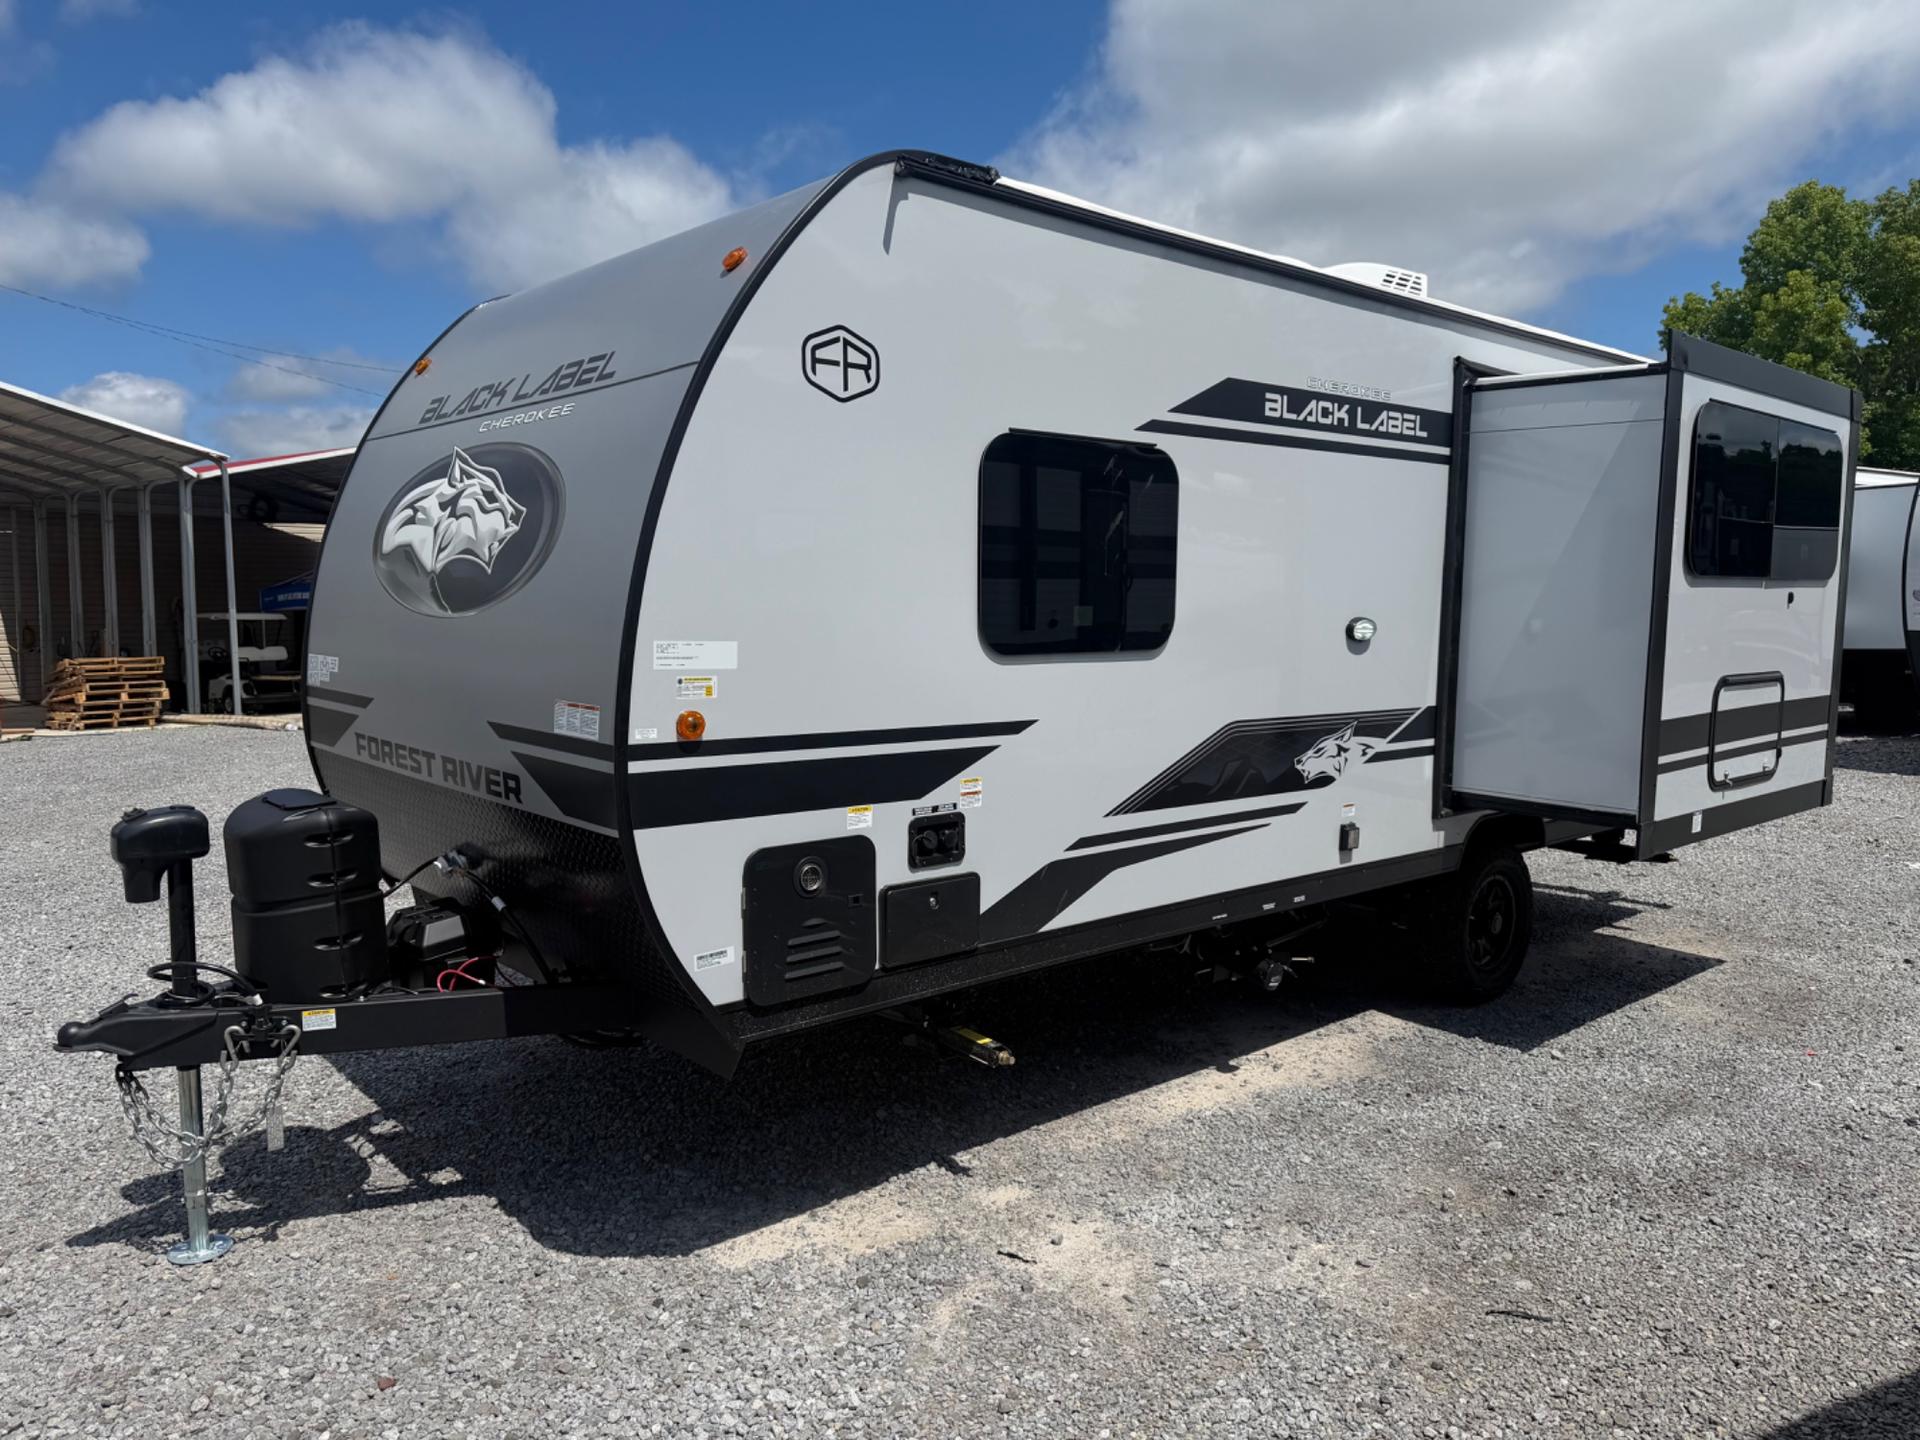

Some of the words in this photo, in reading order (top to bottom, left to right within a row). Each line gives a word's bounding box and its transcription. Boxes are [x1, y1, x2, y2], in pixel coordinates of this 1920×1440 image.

[418, 376, 516, 424] BLACK
[511, 351, 616, 402] LABEL
[1306, 376, 1393, 401] CHEROKEE
[479, 402, 576, 432] CHEROKEE
[1264, 392, 1350, 427] BLACK
[1356, 406, 1428, 438] LABEL
[354, 732, 436, 778] FOREST
[441, 755, 524, 804] RIVER
